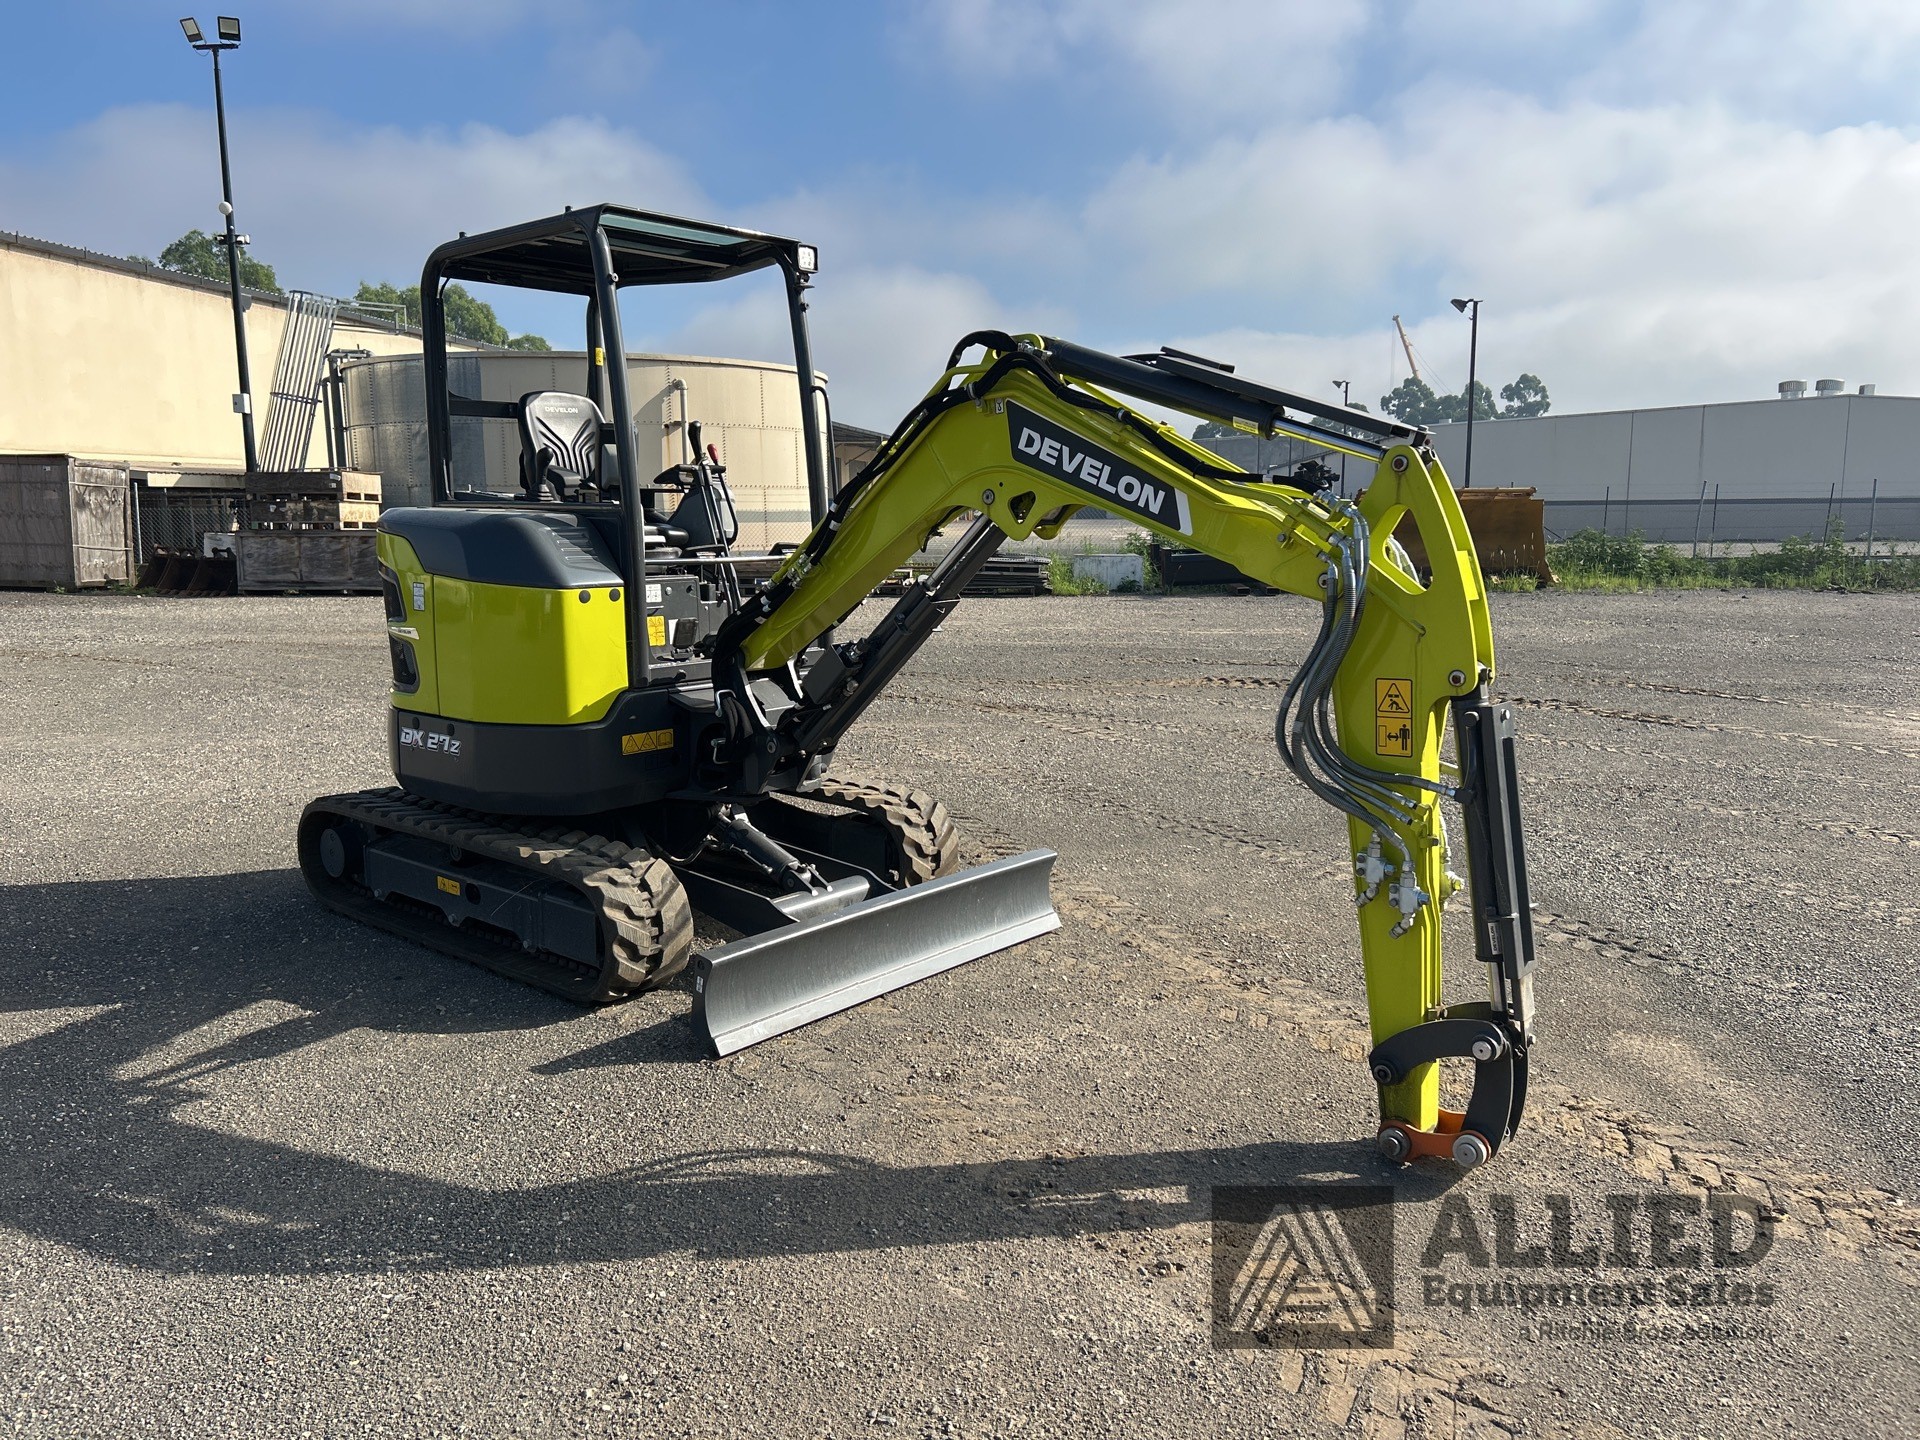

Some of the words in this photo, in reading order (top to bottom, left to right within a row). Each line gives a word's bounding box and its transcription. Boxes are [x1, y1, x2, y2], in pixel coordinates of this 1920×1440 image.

[544, 406, 579, 414] DEVELON
[1017, 426, 1166, 515] DEVELON
[400, 727, 425, 749] DX
